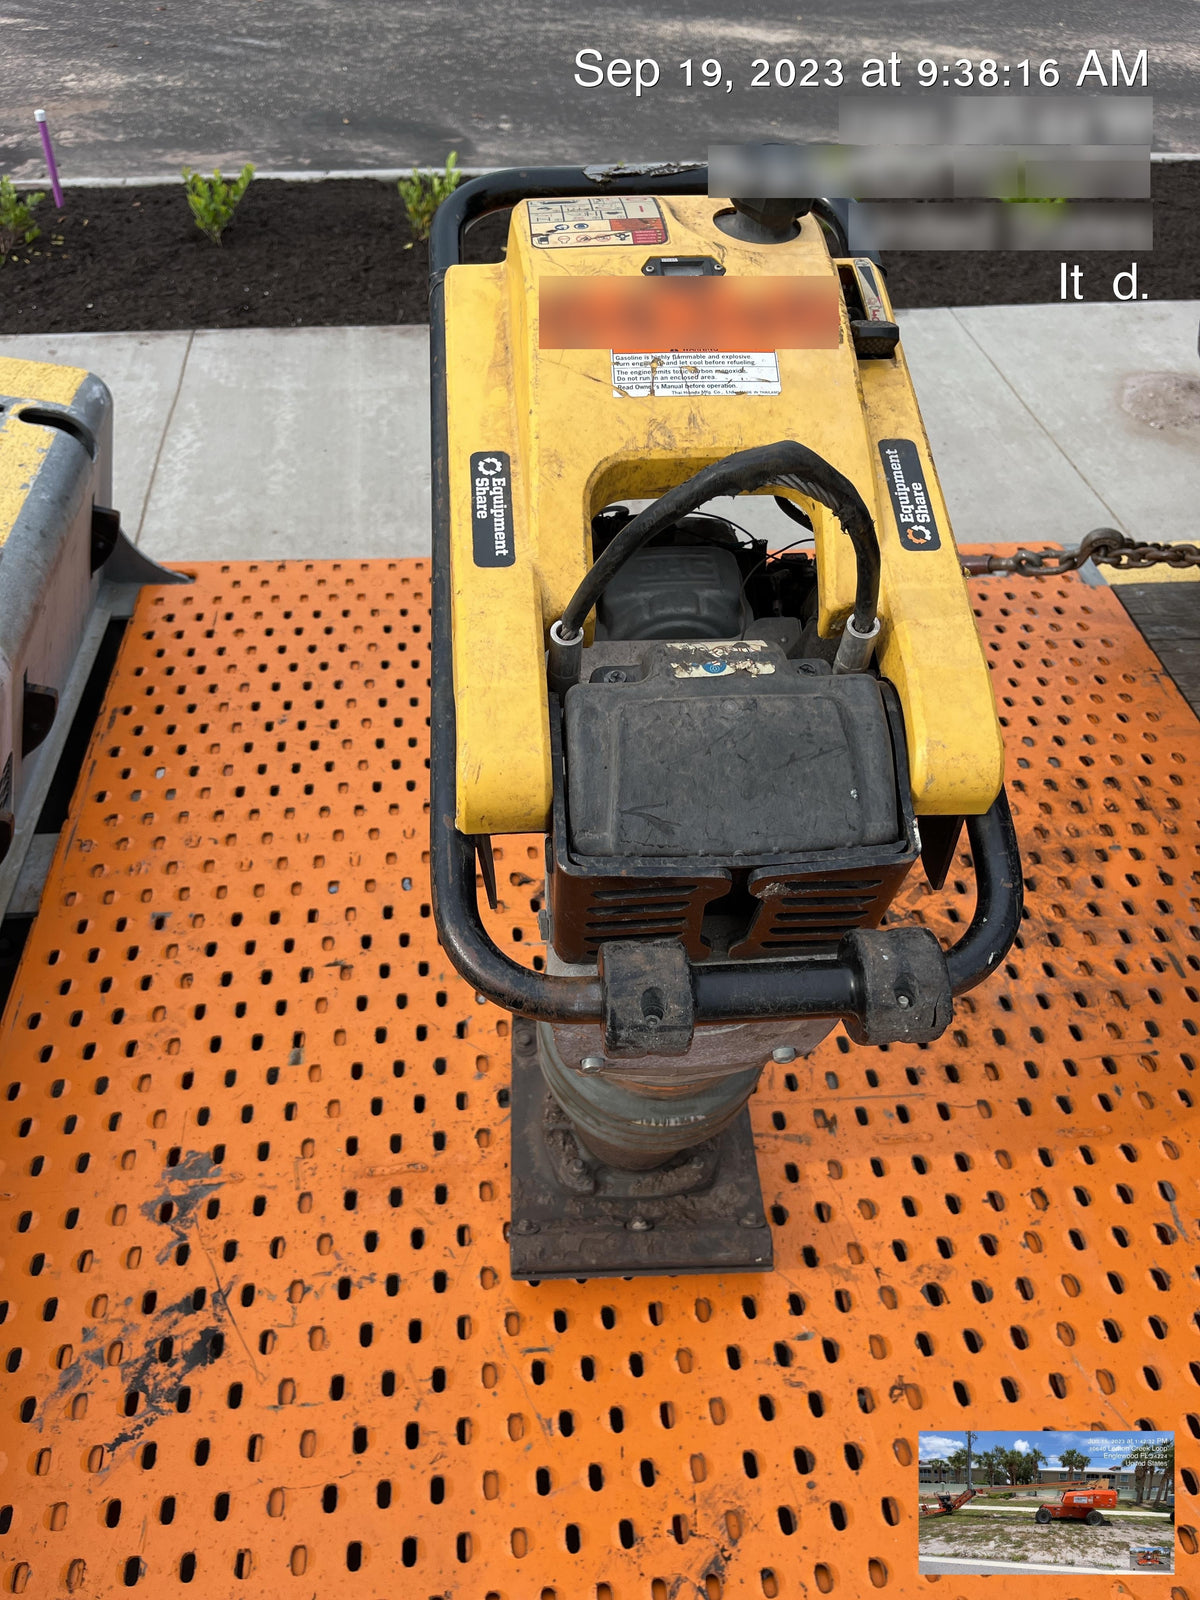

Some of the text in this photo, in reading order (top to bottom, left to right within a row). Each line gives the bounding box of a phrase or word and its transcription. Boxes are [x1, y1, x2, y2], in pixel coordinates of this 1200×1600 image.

[721, 353, 752, 361] explosive.
[475, 477, 490, 519] Share
[885, 448, 915, 523] Equipment
[911, 482, 931, 523] Share
[489, 477, 509, 556] Equipment
